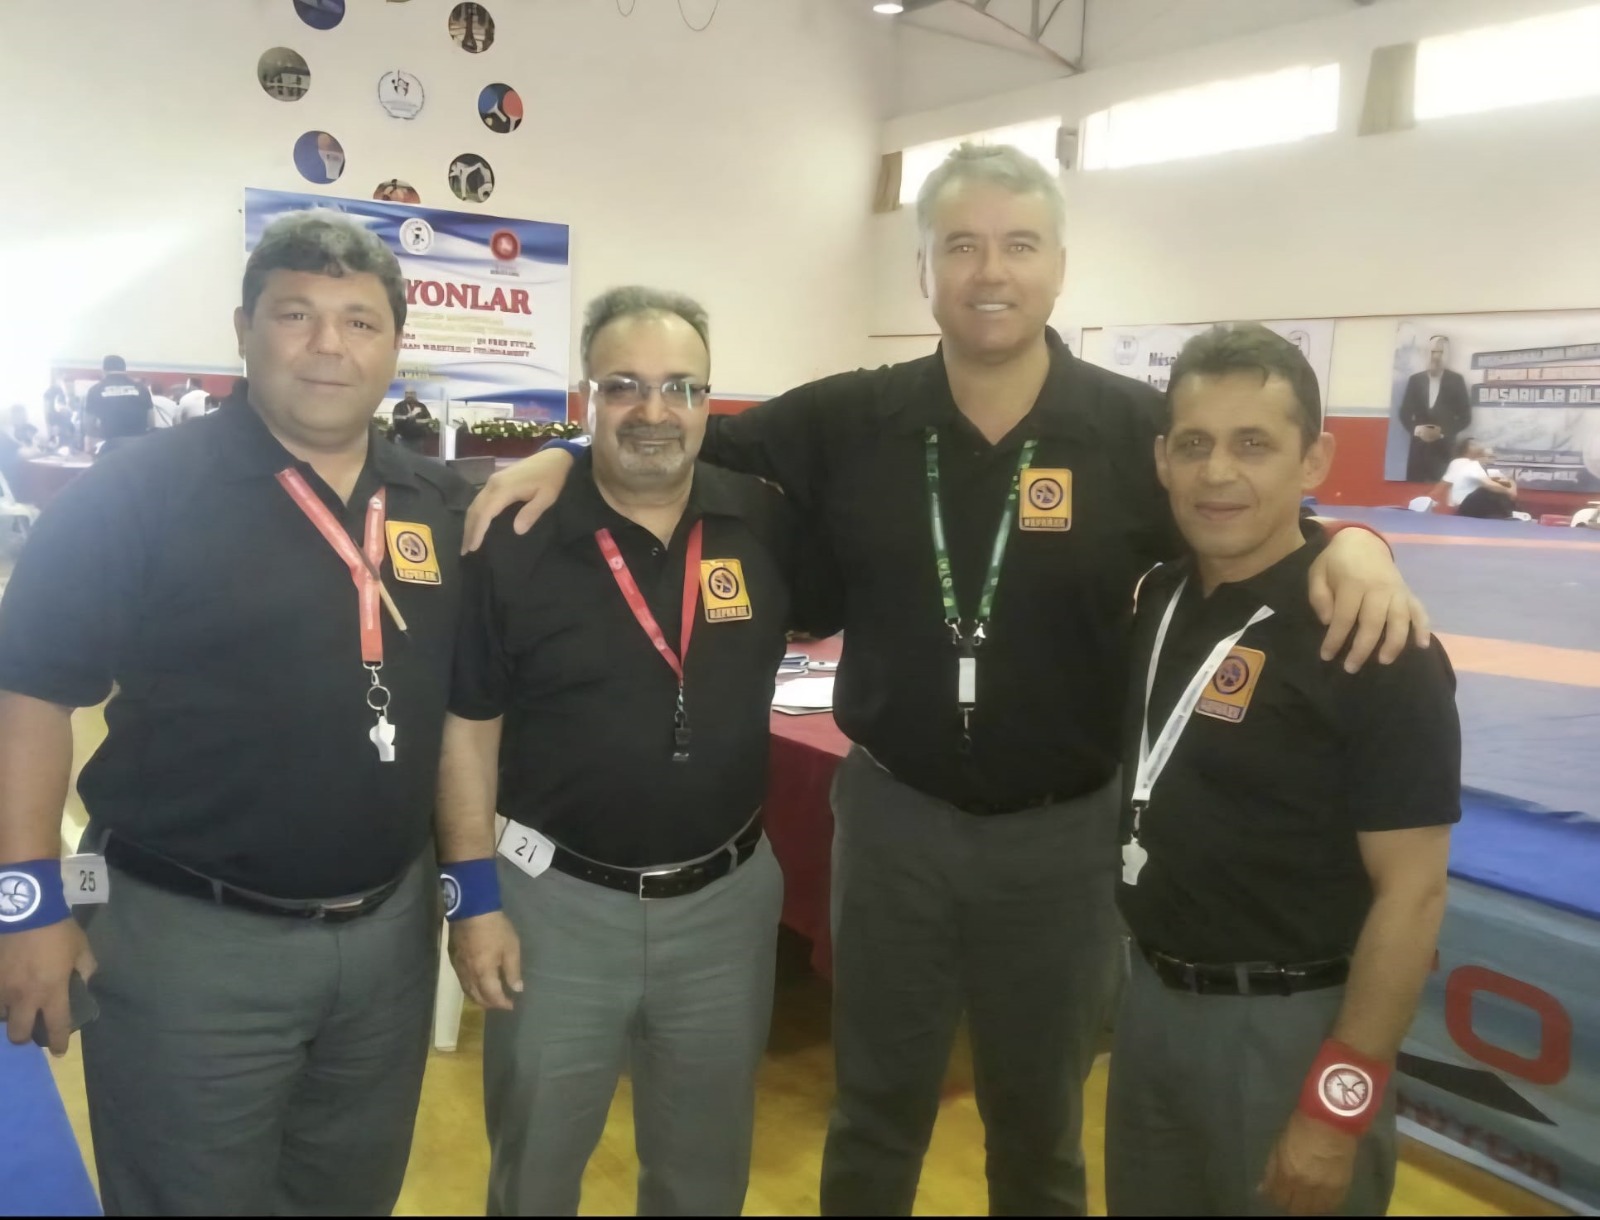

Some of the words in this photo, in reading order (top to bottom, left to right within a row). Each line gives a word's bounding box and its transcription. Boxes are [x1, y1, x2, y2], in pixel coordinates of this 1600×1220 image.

[406, 279, 532, 315] YONLAR
[514, 836, 538, 863] 21
[80, 870, 96, 892] 25
[1432, 948, 1573, 1086] O
